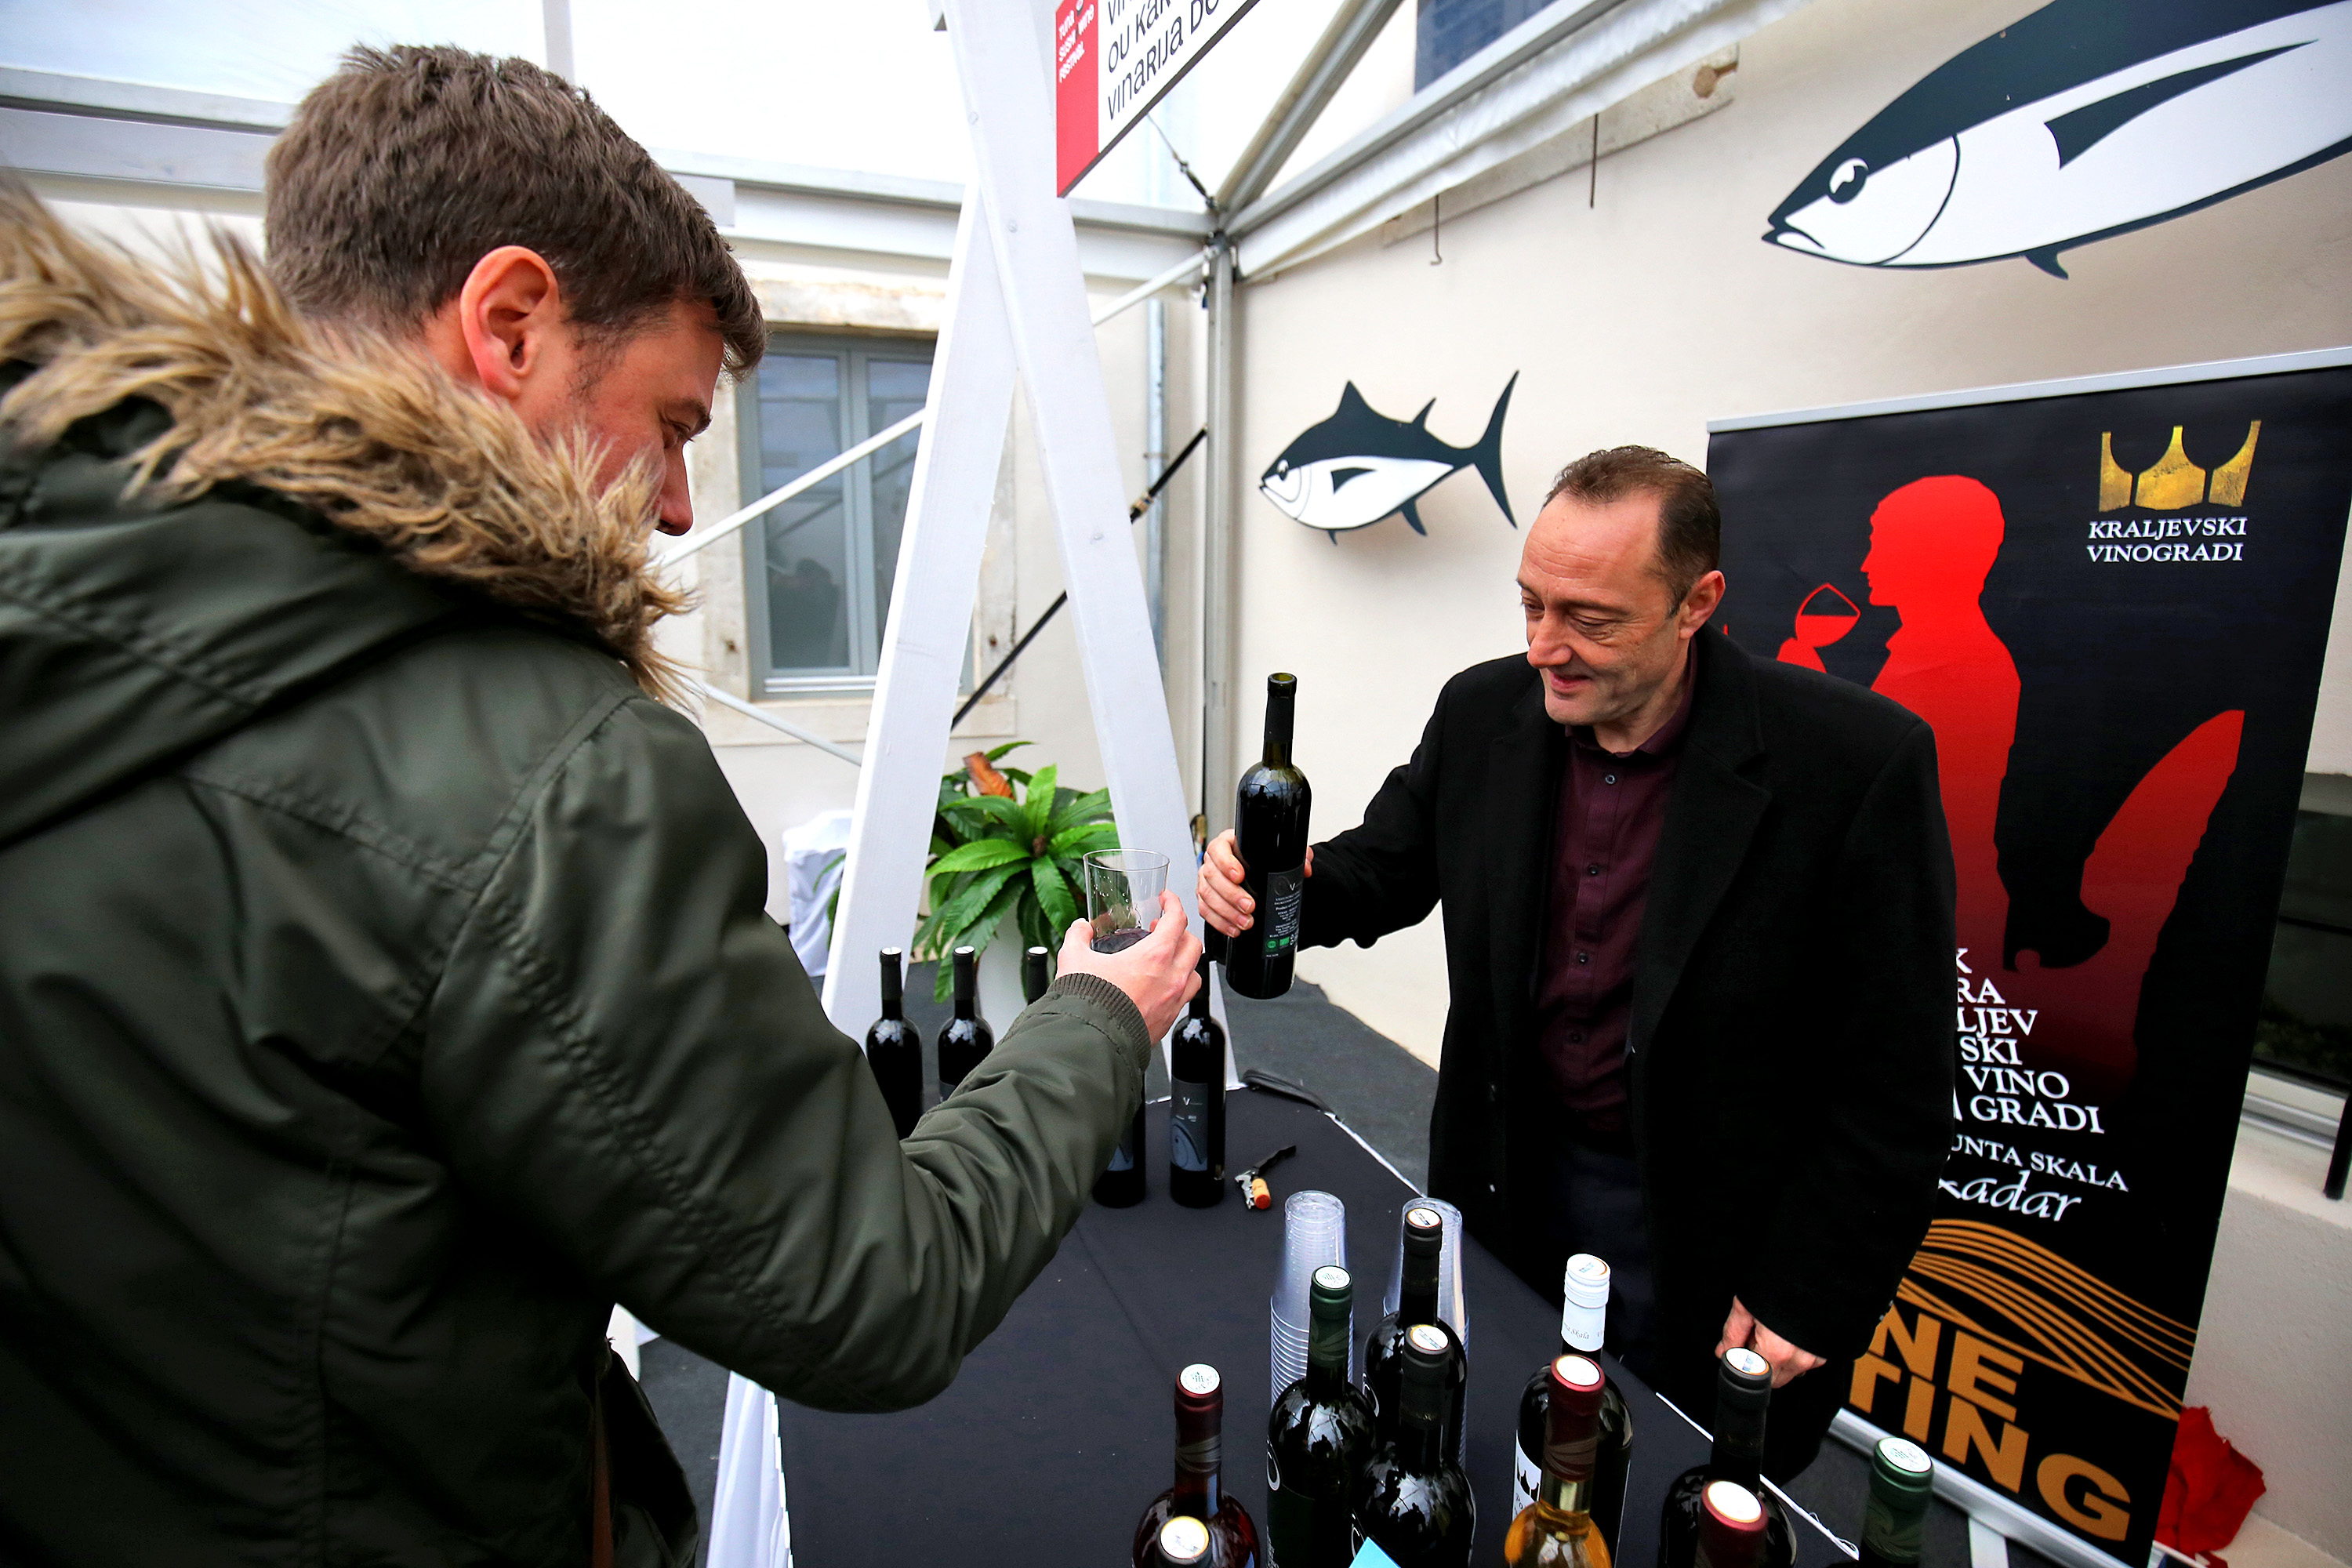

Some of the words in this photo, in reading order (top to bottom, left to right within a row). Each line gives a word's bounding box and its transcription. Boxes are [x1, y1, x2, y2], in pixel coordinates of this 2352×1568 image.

[2089, 517, 2248, 541] KRALJEVSKI
[2086, 542, 2244, 563] VINOGRADI
[1957, 976, 2005, 1004] RA
[1957, 1007, 2038, 1039] LJEV
[1959, 1035, 2023, 1066] SKI
[1962, 1065, 2070, 1099] VINO
[1969, 1094, 2106, 1134] GRADI
[2029, 1151, 2130, 1193] SKALA
